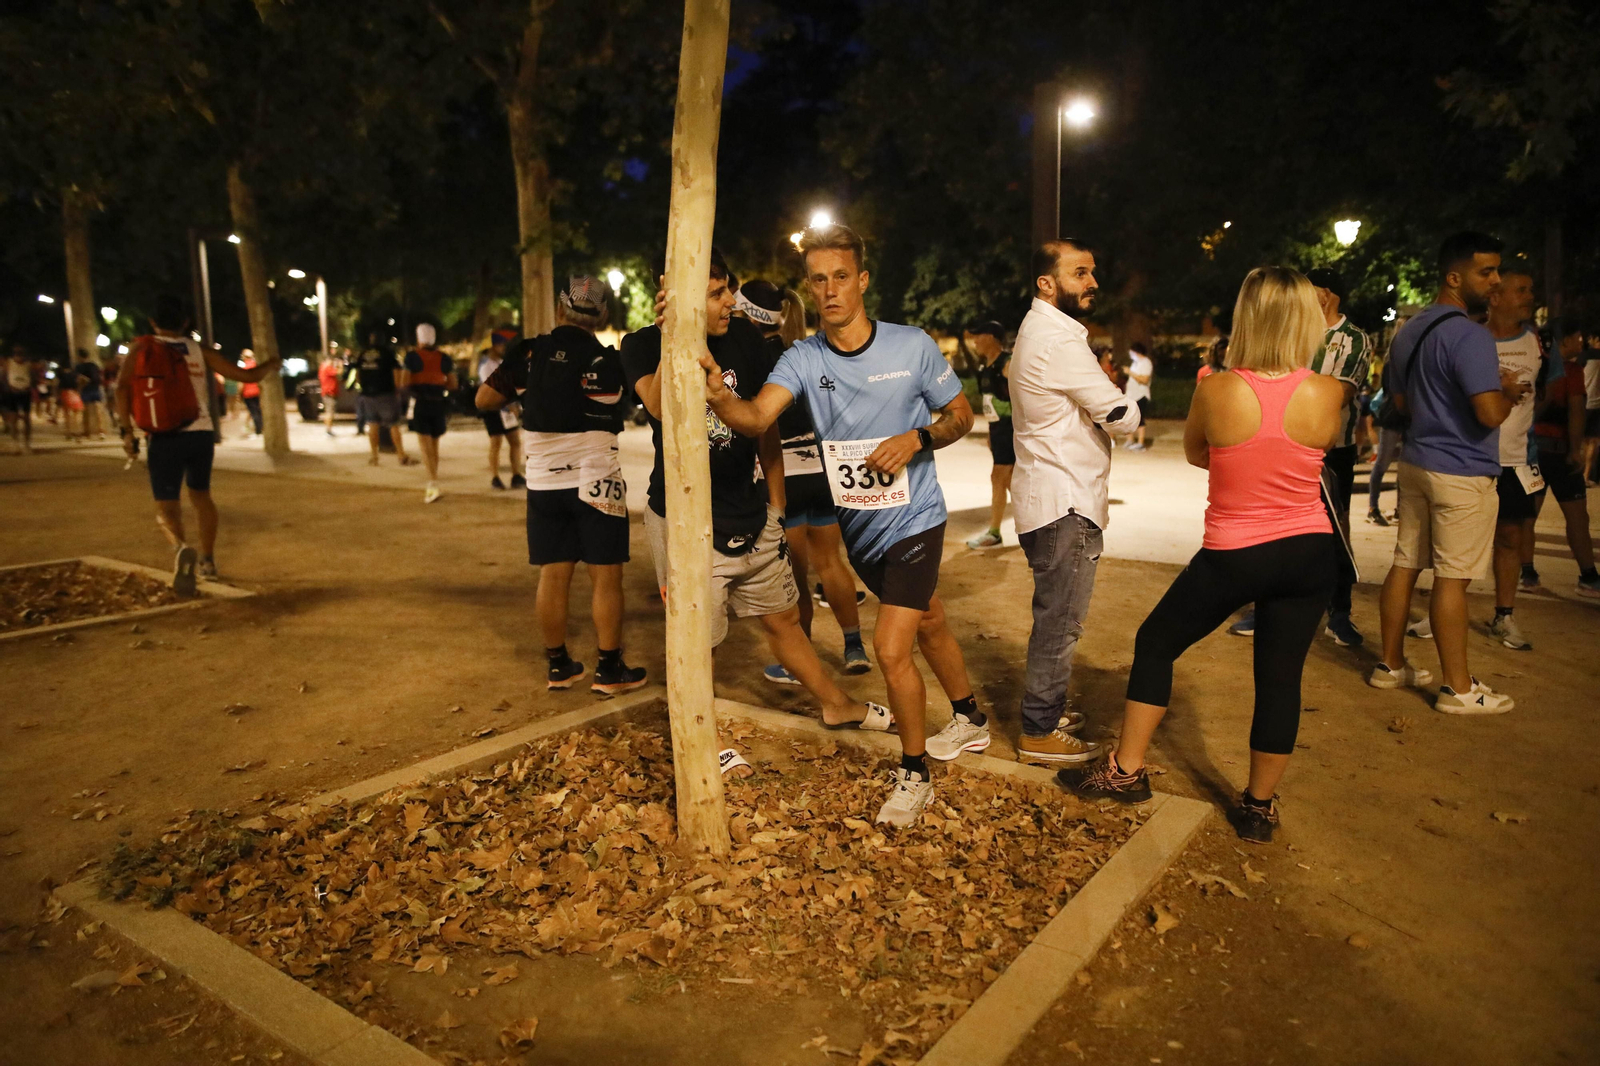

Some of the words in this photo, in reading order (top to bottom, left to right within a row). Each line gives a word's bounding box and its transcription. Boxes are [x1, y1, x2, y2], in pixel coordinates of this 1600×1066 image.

[867, 370, 912, 383] SCARPA
[588, 479, 622, 501] 375
[841, 490, 906, 507] alssport.es
[719, 751, 734, 762] NIKE
